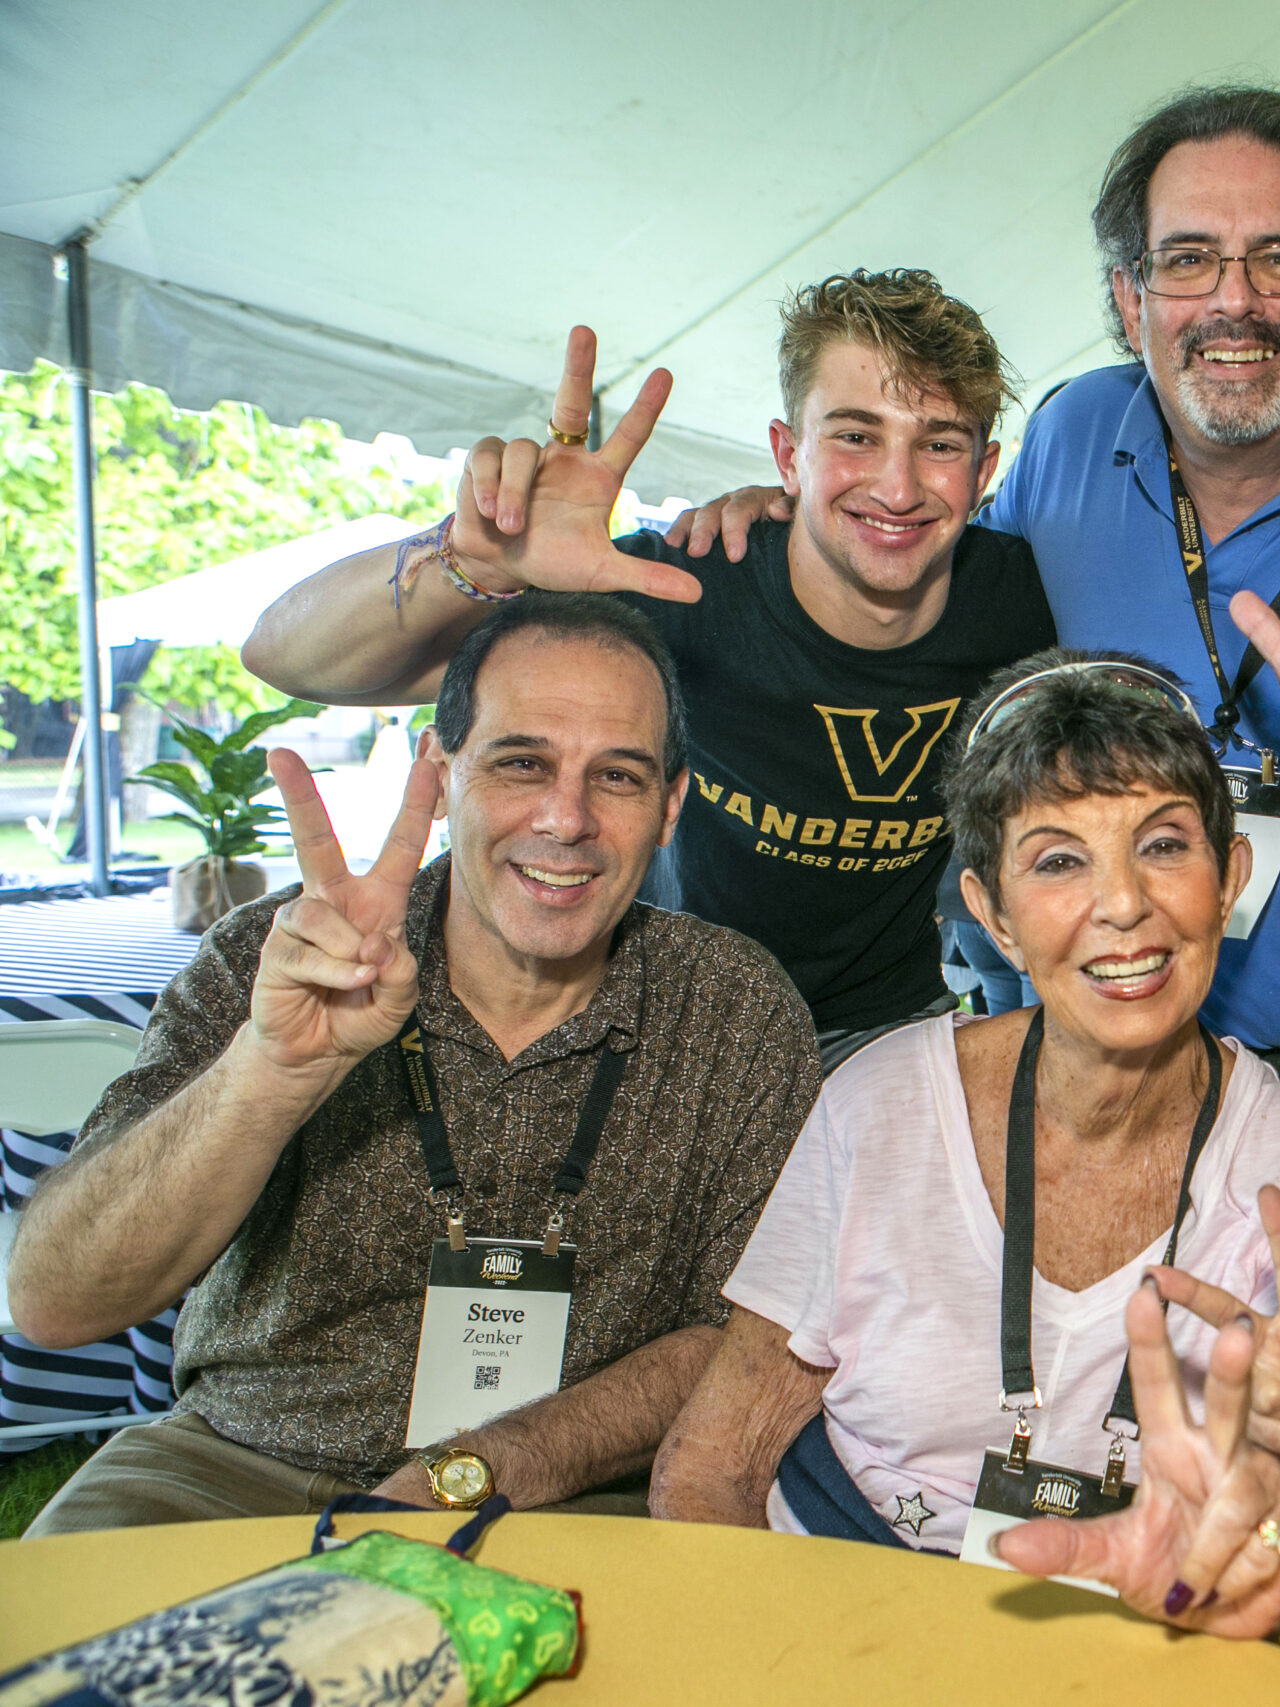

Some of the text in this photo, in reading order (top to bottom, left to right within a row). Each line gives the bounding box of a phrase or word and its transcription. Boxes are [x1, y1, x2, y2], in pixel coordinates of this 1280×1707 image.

[1177, 496, 1191, 550] VANDERBILT
[1185, 497, 1199, 548] UNIVERSITY
[1183, 551, 1202, 576] V
[813, 697, 961, 802] V
[755, 840, 832, 868] CLASS
[837, 856, 870, 872] OF
[401, 1027, 424, 1053] V
[406, 1056, 425, 1112] UNIVERSITY
[414, 1054, 433, 1112] VANDERBILT
[480, 1272, 523, 1280] Weekend
[483, 1255, 522, 1274] FAMILY
[467, 1303, 525, 1323] Steve
[462, 1328, 523, 1345] Zenker
[472, 1348, 510, 1358] Devon, PA
[1032, 1499, 1080, 1517] Weekend
[1035, 1481, 1080, 1509] FAMILY
